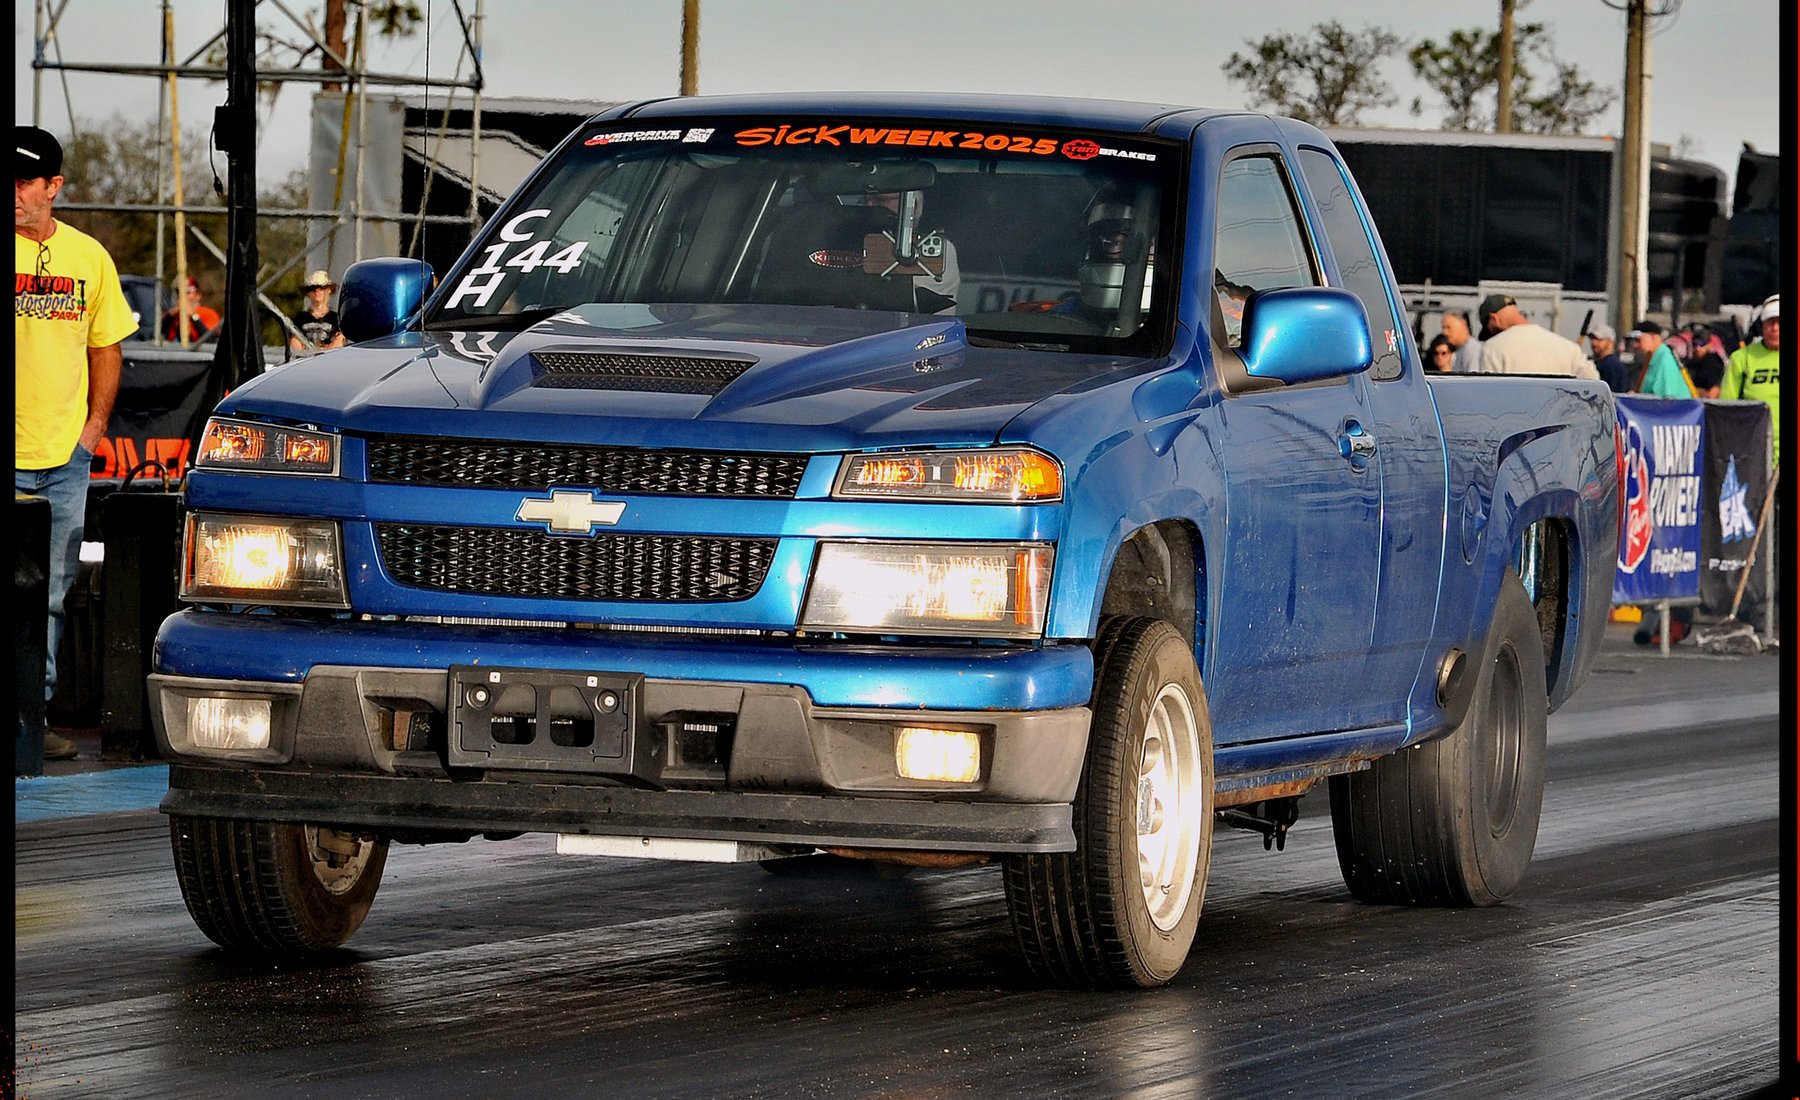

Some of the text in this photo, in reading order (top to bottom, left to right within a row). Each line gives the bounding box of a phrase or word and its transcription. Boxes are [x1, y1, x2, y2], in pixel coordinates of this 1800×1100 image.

[850, 128, 961, 147] WEEK
[959, 133, 1059, 154] 2025
[1098, 148, 1157, 162] BRAKES
[500, 209, 552, 242] C
[469, 240, 589, 275] 144
[444, 272, 507, 309] H
[49, 310, 79, 321] PARK
